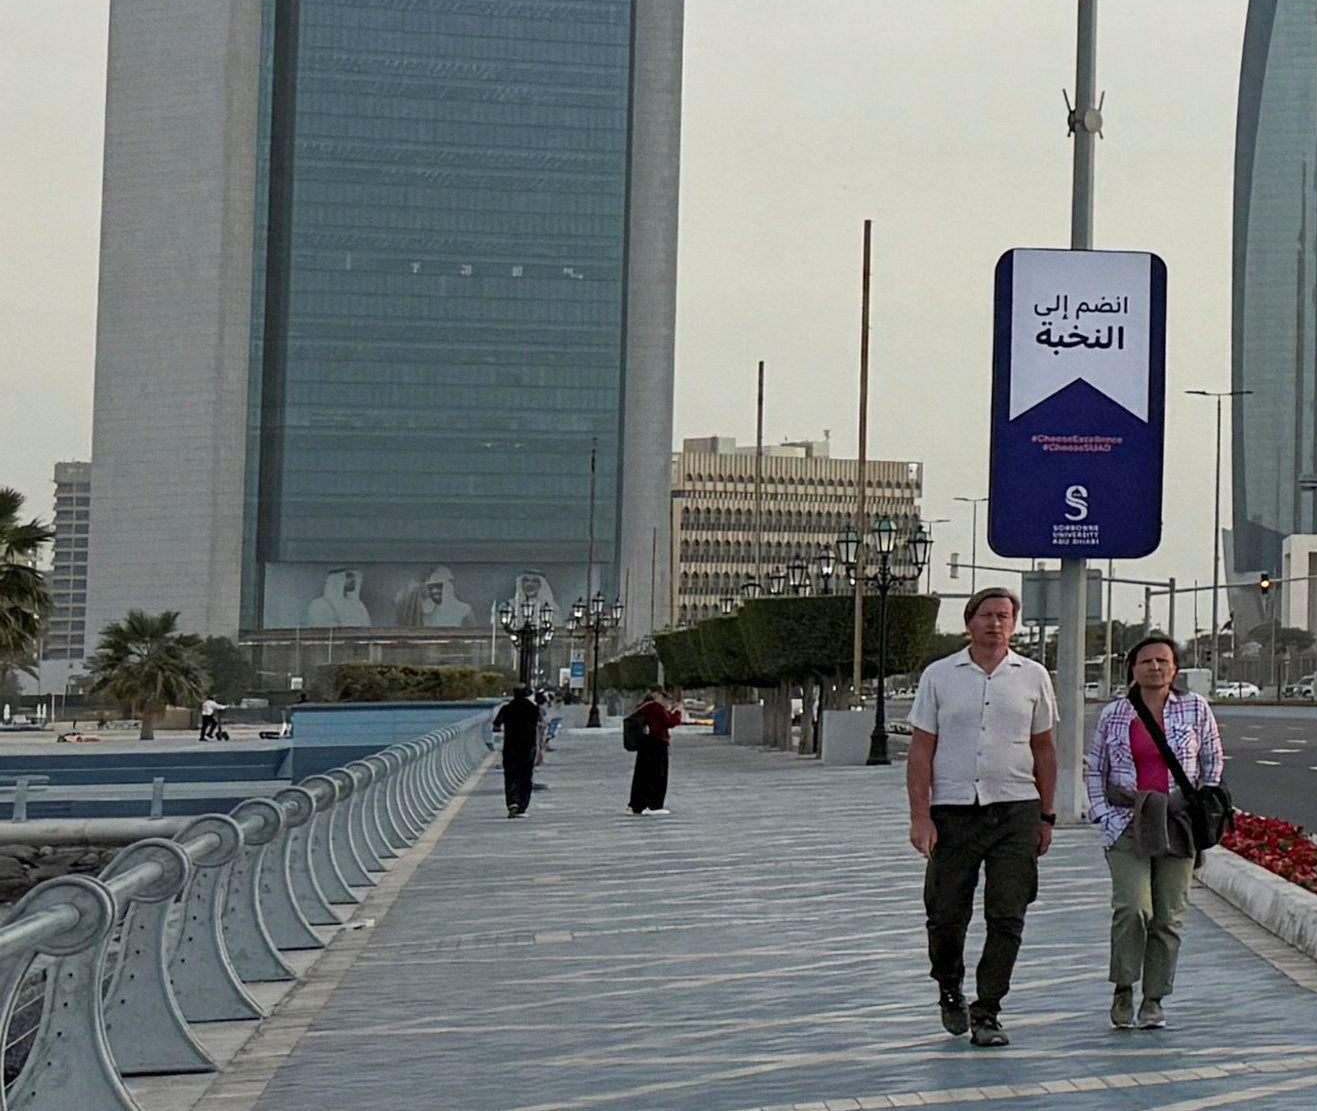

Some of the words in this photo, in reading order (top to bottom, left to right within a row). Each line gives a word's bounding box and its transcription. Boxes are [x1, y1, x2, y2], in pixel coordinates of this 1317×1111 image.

[1034, 295, 1068, 319] إلى
[1076, 296, 1128, 319] انضم
[1036, 321, 1124, 355] النخبة
